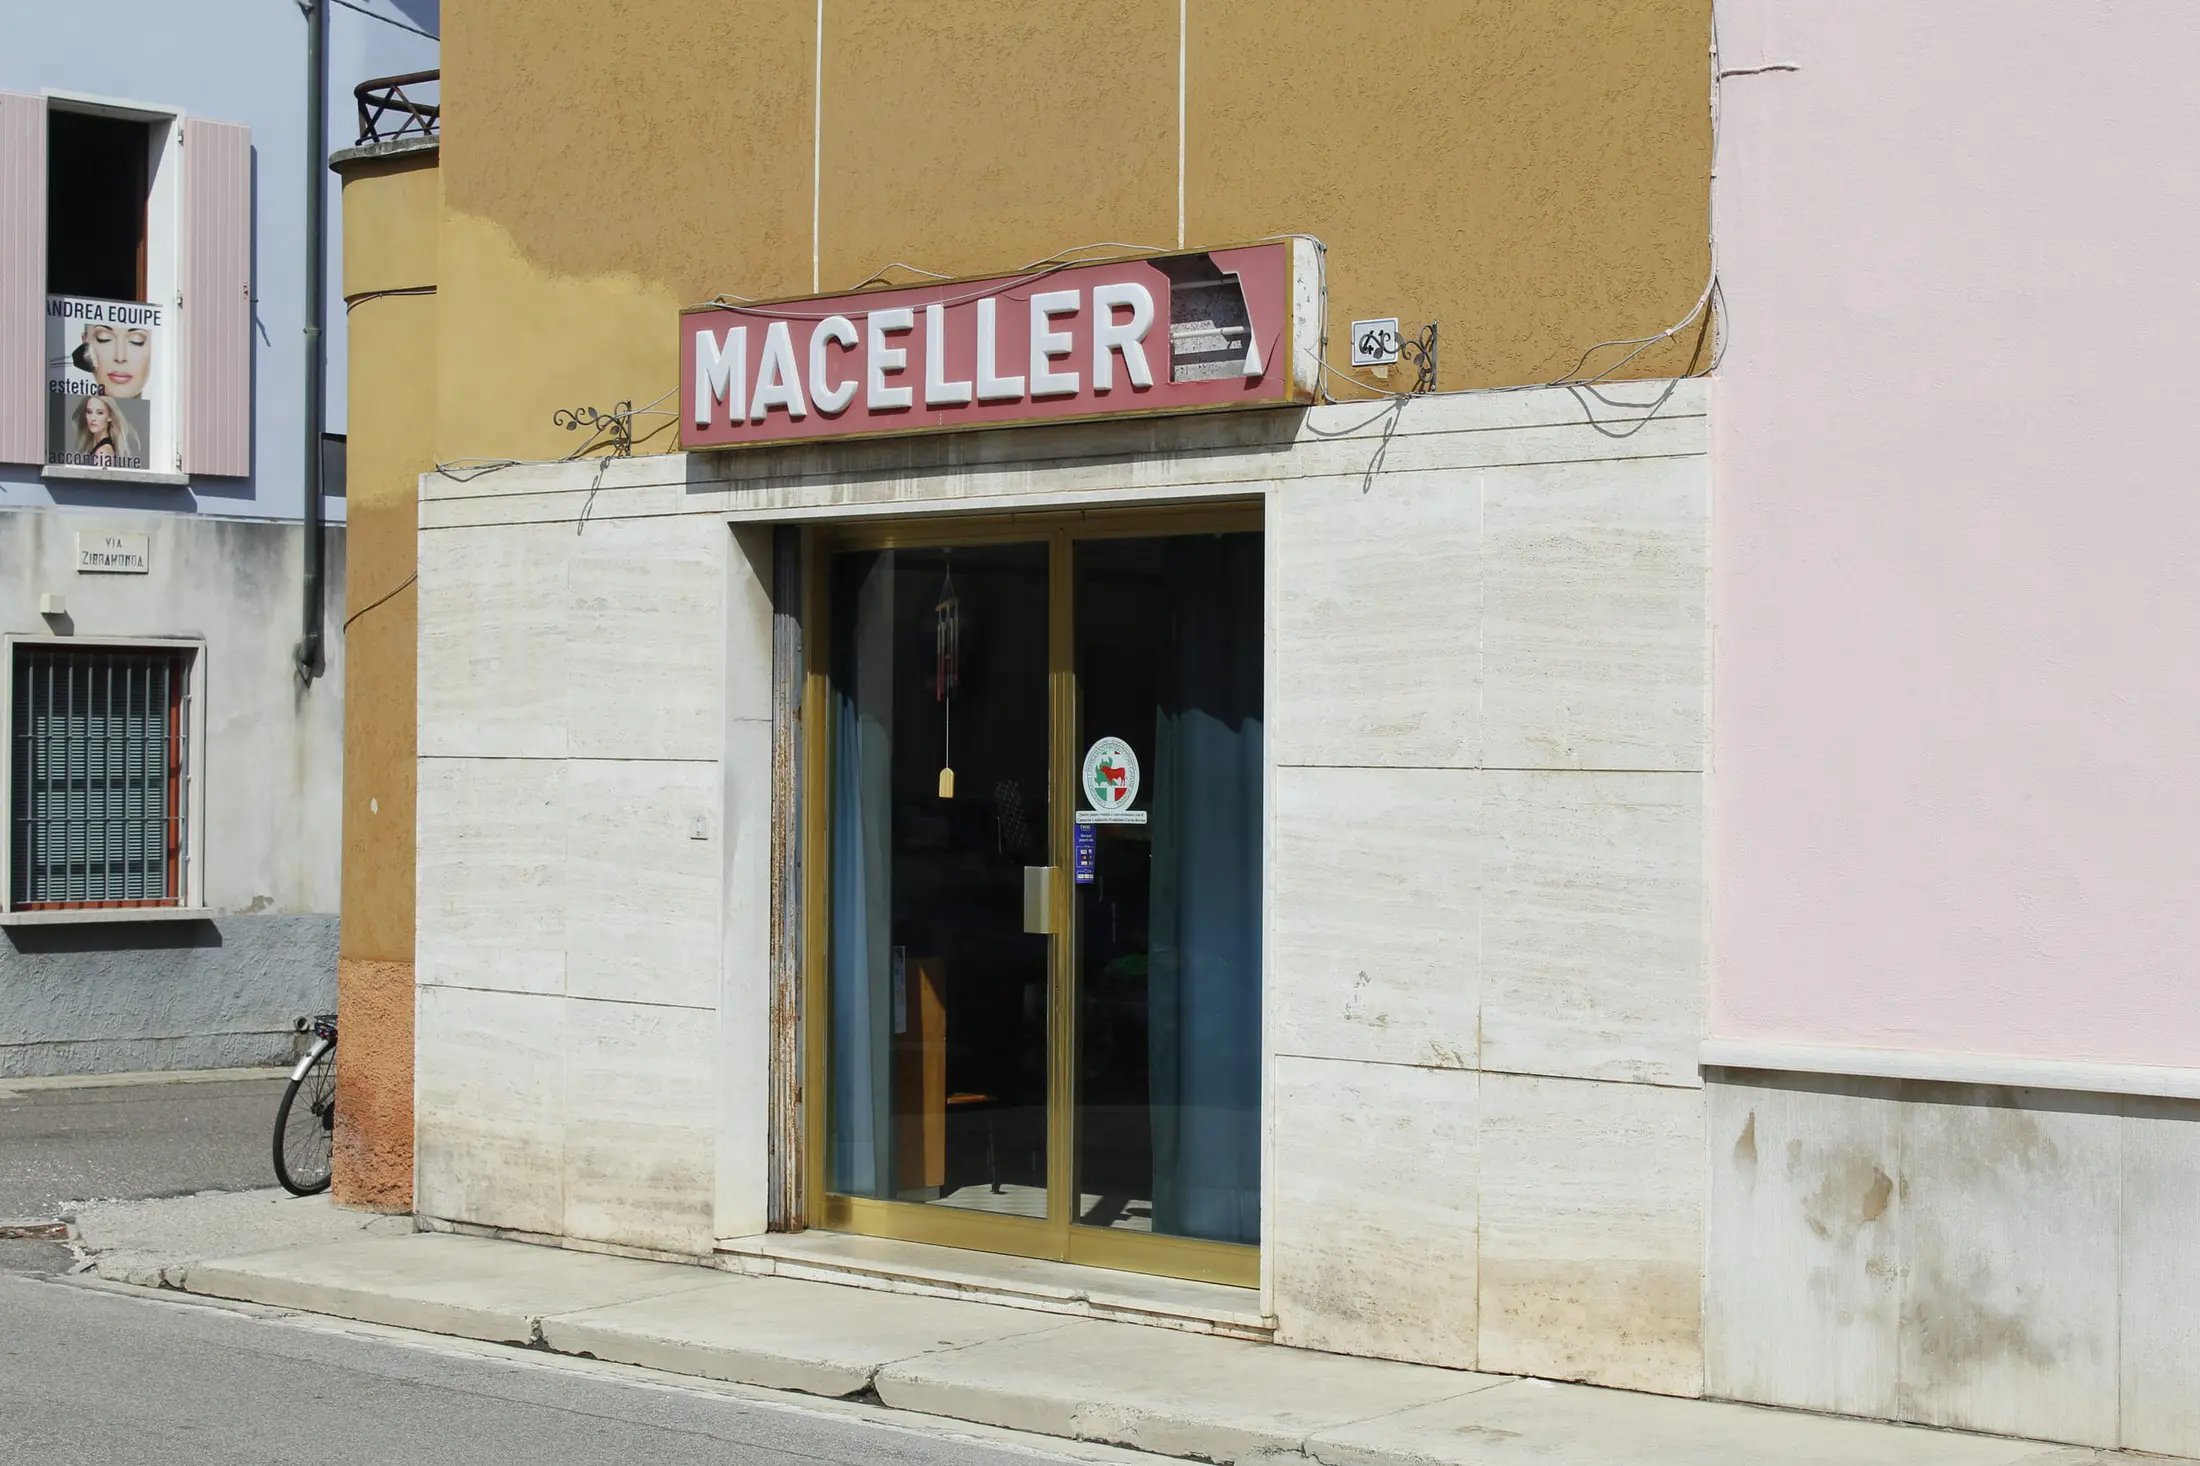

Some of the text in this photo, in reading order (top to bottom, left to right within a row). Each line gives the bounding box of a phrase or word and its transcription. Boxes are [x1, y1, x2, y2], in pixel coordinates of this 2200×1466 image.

[108, 306, 162, 326] EQUIPE
[694, 281, 1265, 426] MACELLER
[49, 379, 106, 397] estetica
[48, 451, 141, 469] acconciature
[105, 537, 123, 549] VIA
